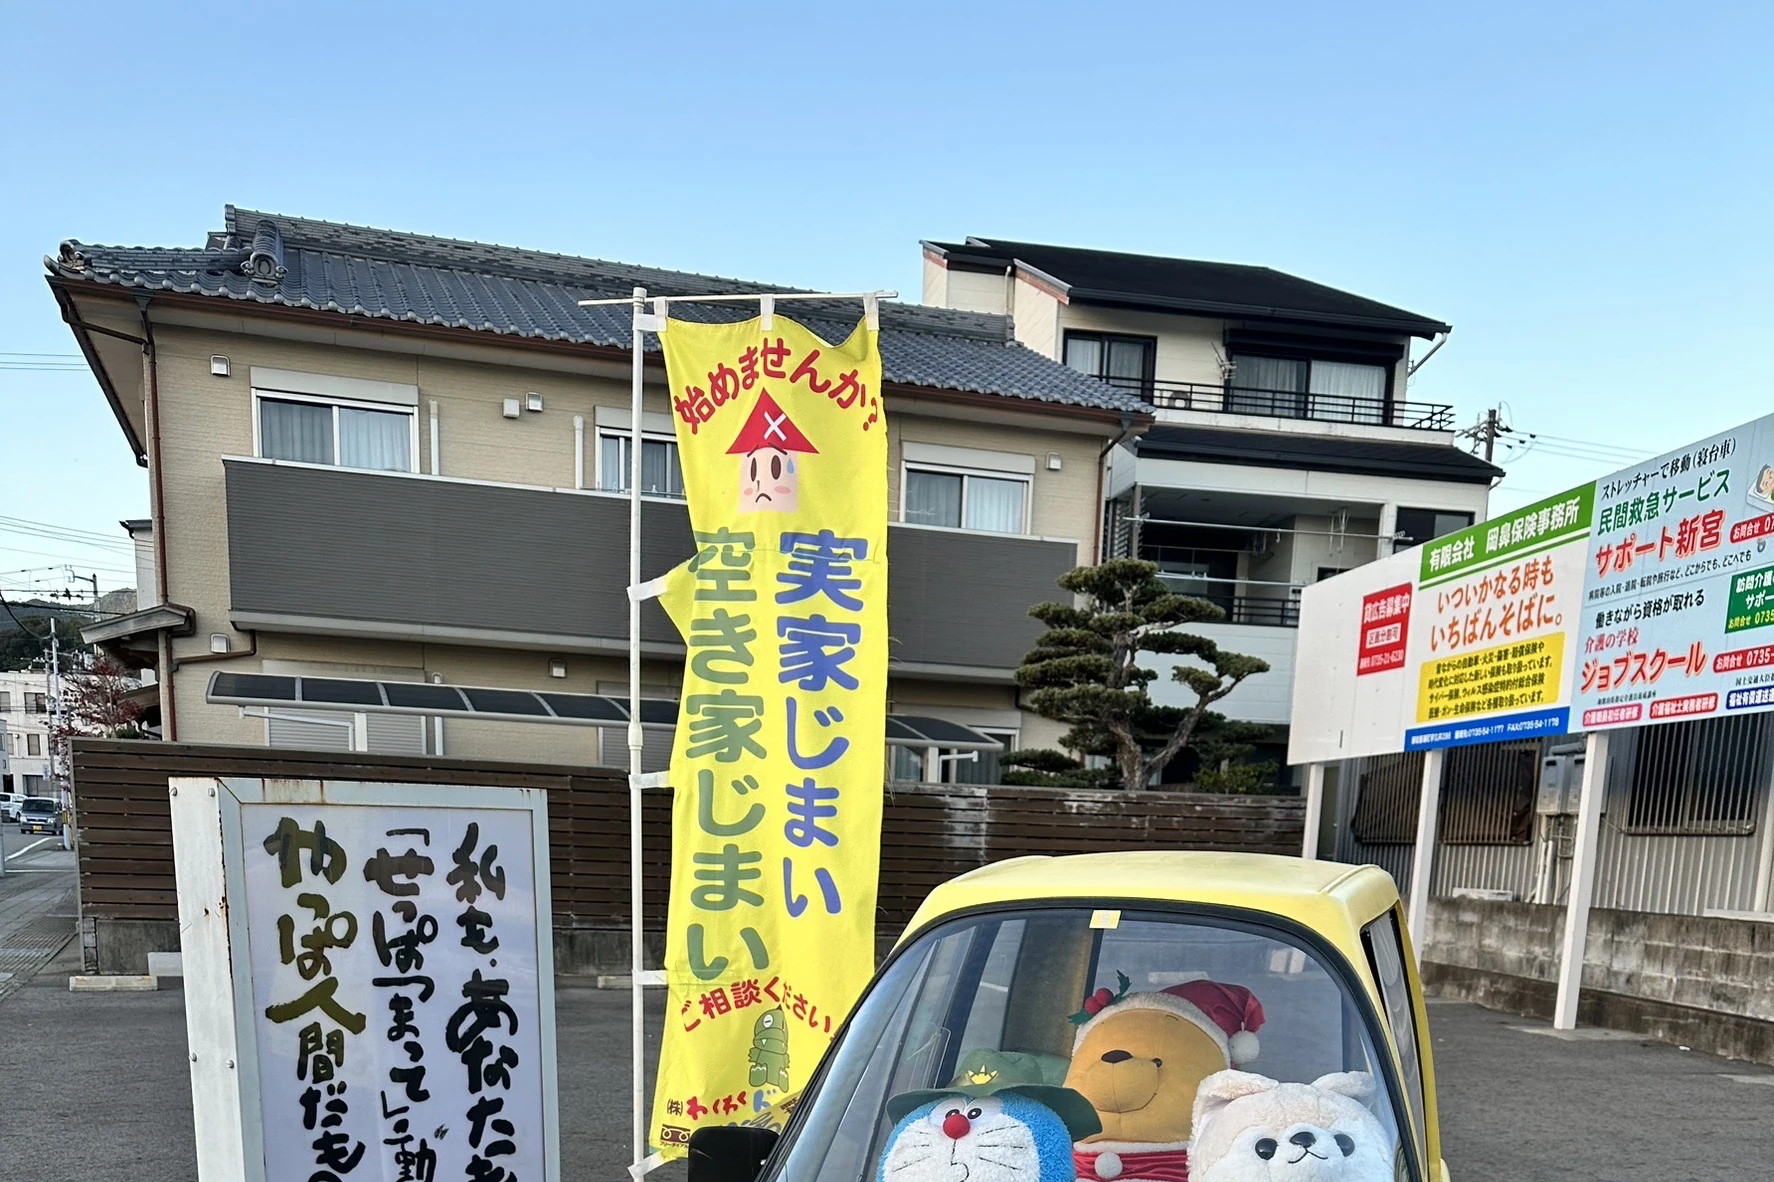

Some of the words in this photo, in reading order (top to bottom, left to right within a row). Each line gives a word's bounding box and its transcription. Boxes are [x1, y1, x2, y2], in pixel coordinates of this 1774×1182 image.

[674, 337, 878, 435] 始めませんか？
[1598, 469, 1730, 536] 民間救急サービス
[1429, 535, 1475, 573] 有限会社
[1596, 509, 1725, 579] サポート新宮
[1733, 521, 1761, 540] お問合せ
[1437, 555, 1554, 614] いついかなる時も
[1595, 589, 1705, 629] 働きながら資格が取れる
[1736, 570, 1774, 593] 訪問介護
[1430, 592, 1563, 652] いちばんそばに。
[1584, 627, 1639, 654] 介護の学校
[1580, 641, 1707, 693] ジョブスクール
[1715, 655, 1743, 671] お問合せ
[774, 529, 868, 918] 実家じまい
[686, 526, 769, 981] 空き家じまい
